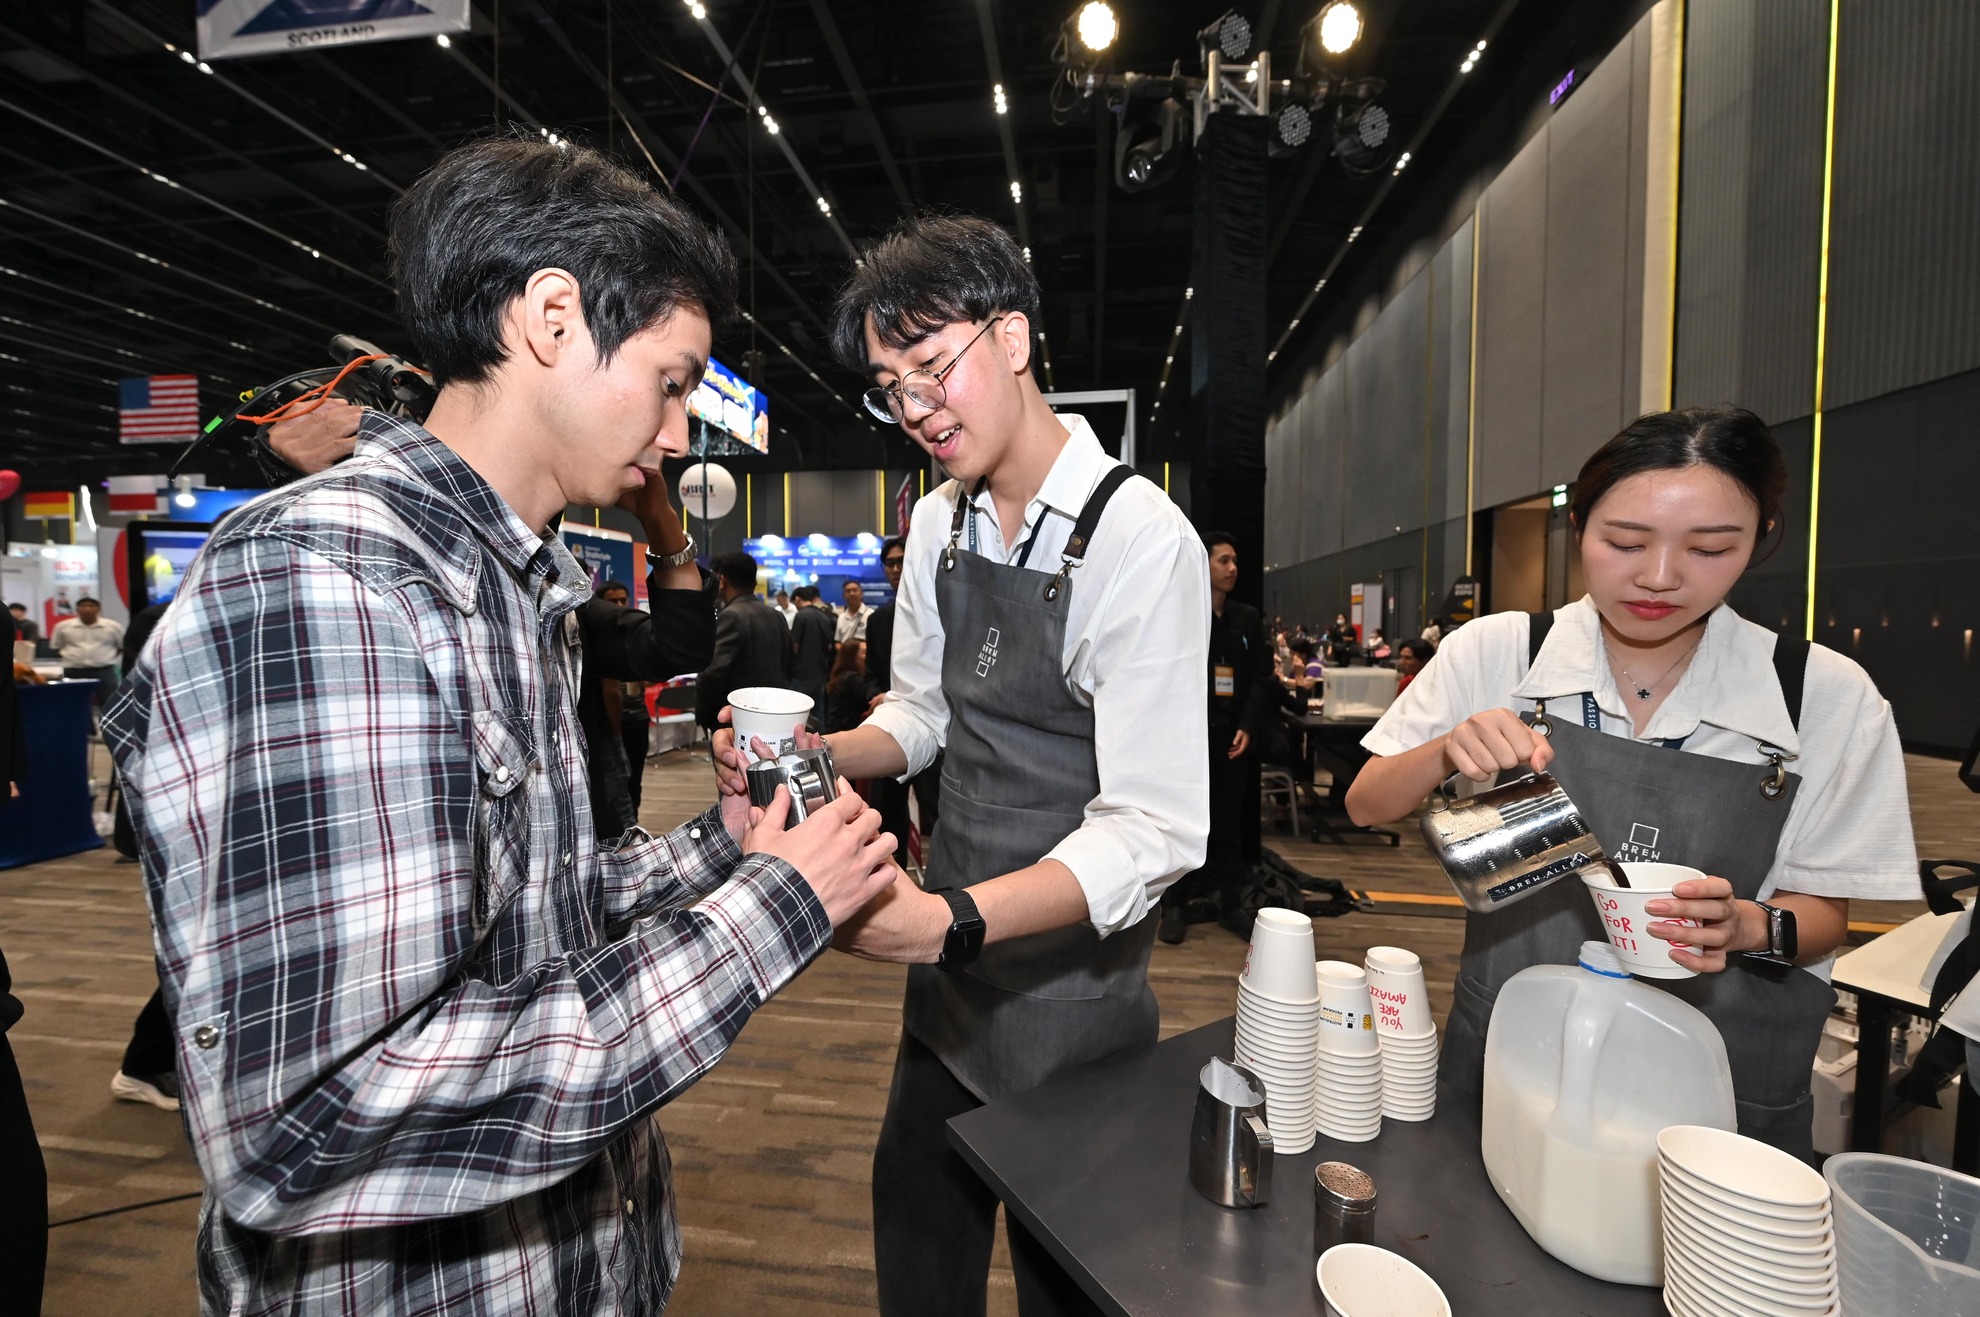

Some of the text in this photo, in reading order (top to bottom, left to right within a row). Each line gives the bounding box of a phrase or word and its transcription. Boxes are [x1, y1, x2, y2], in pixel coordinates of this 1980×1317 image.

[287, 24, 376, 48] SCOTLAND
[978, 652, 997, 666] ALLEY
[982, 644, 998, 658] BREW
[1587, 698, 1597, 731] PASSIO
[1614, 852, 1661, 863] ALL
[1621, 843, 1661, 860] BREW
[1508, 857, 1584, 892] BREW ALLEY
[1612, 936, 1638, 955] IT!
[1379, 1003, 1399, 1016] ARE
